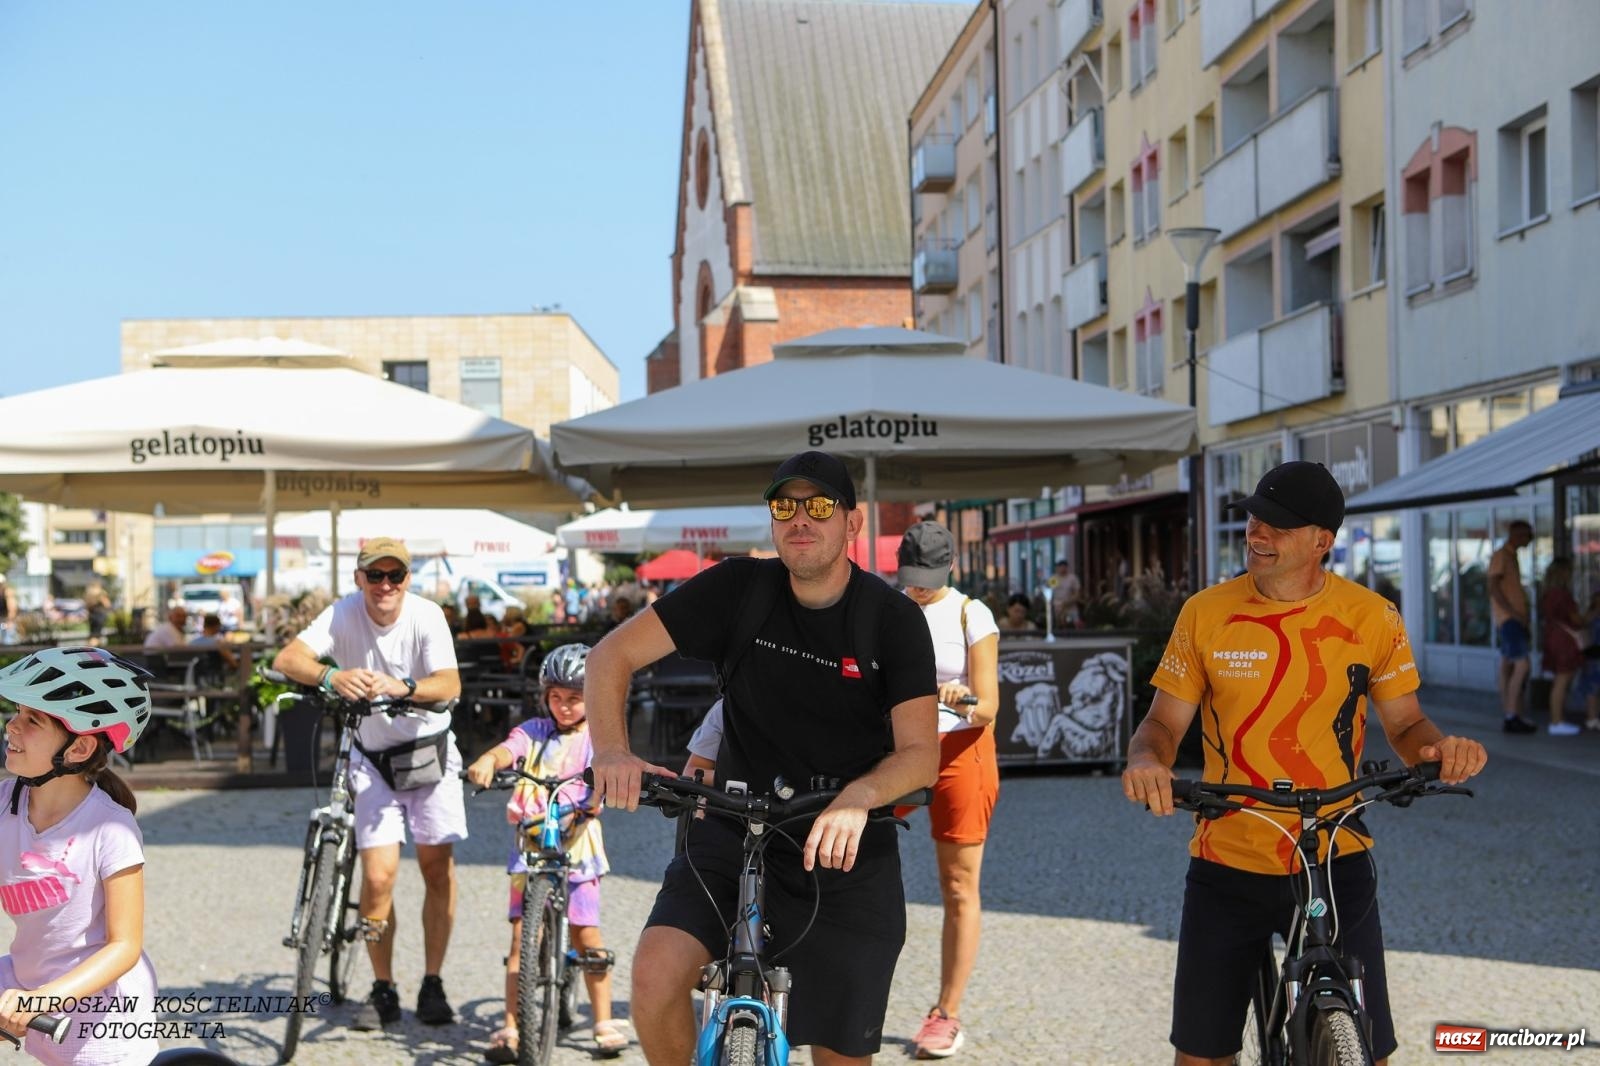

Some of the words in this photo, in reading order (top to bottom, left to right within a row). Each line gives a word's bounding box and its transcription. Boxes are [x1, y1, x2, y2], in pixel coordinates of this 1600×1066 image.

[808, 413, 939, 447] gelatopiu
[130, 430, 265, 463] gelatopiu
[755, 638, 776, 648] NEVER
[781, 646, 797, 654] STOP
[802, 652, 838, 667] EXPORING
[1213, 649, 1267, 659] WSCHÓD
[1218, 670, 1260, 678] FINISHER
